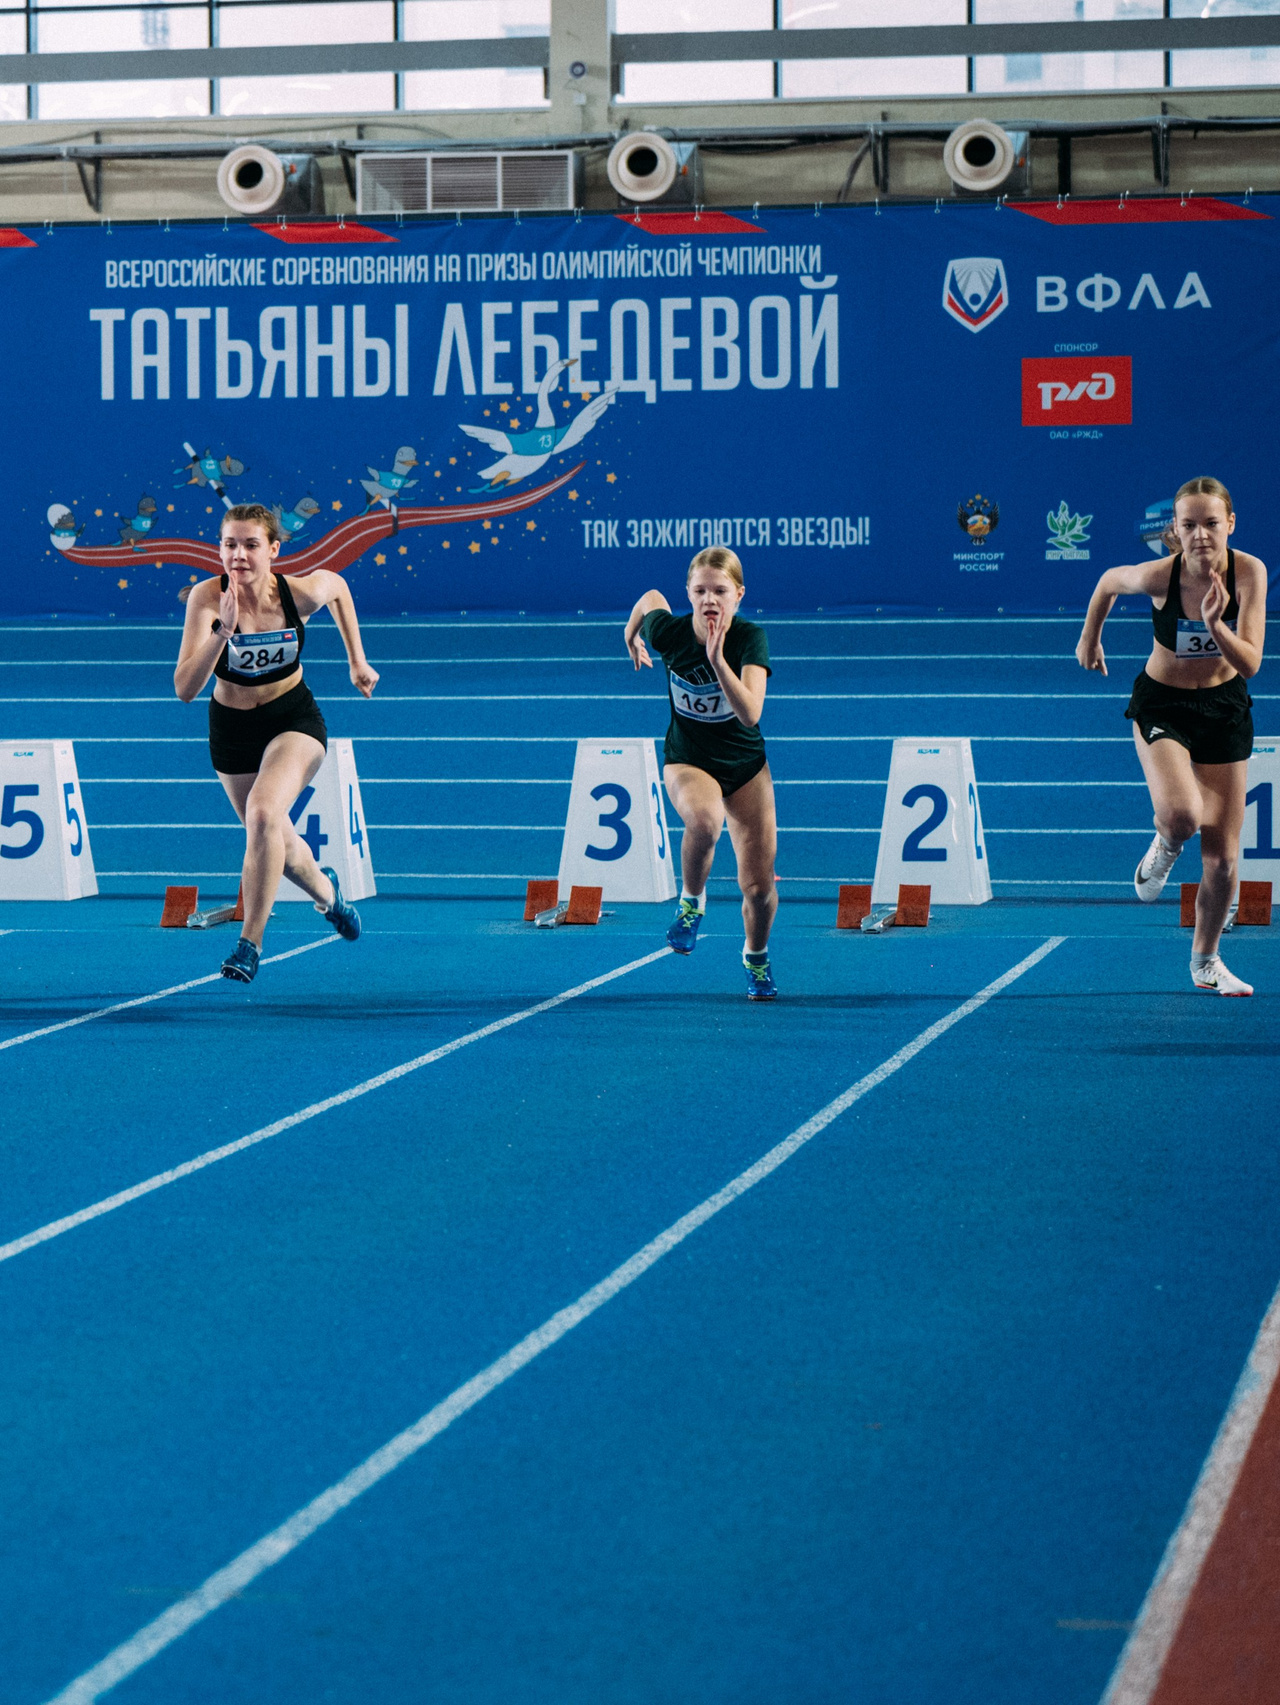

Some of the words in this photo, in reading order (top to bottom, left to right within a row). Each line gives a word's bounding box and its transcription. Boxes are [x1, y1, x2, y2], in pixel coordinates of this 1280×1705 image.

[105, 253, 266, 289] ВСЕРОССИЙСКИЕ
[272, 254, 429, 286] СОРЕВНОВАНИЯ
[434, 254, 461, 283] НА
[466, 252, 537, 282] ПРИЗЫ
[542, 243, 692, 281] ОЛИМПИЙСКОЙ
[697, 244, 822, 277] ЧЕМПИОНКИ
[1036, 272, 1212, 313] ВФЛА
[89, 303, 409, 400] ТАТЬЯНЫ
[432, 274, 839, 404] ЛЕБЕДЕВОЙ
[1053, 342, 1099, 353] СПОНСОР
[538, 434, 553, 448] 13
[1049, 430, 1069, 440] ОАО
[581, 519, 621, 549] ТАК
[626, 517, 771, 548] ЗАЖИГАЮТСЯ
[776, 516, 870, 549] ЗВЕЗДЫ!
[1139, 518, 1174, 531] ПРОФЕСС
[953, 552, 1005, 561] МИНСПОРТ
[959, 563, 999, 571] РОССИИ
[240, 646, 285, 670] 284
[681, 692, 721, 714] 167
[0, 783, 45, 860] 5
[63, 782, 83, 857] 5
[288, 785, 328, 862] 4
[348, 783, 364, 859] 4
[584, 782, 633, 862] 3
[651, 781, 666, 860] 3
[901, 783, 949, 862] 2
[968, 782, 983, 860] 2
[1243, 782, 1280, 860] 1
